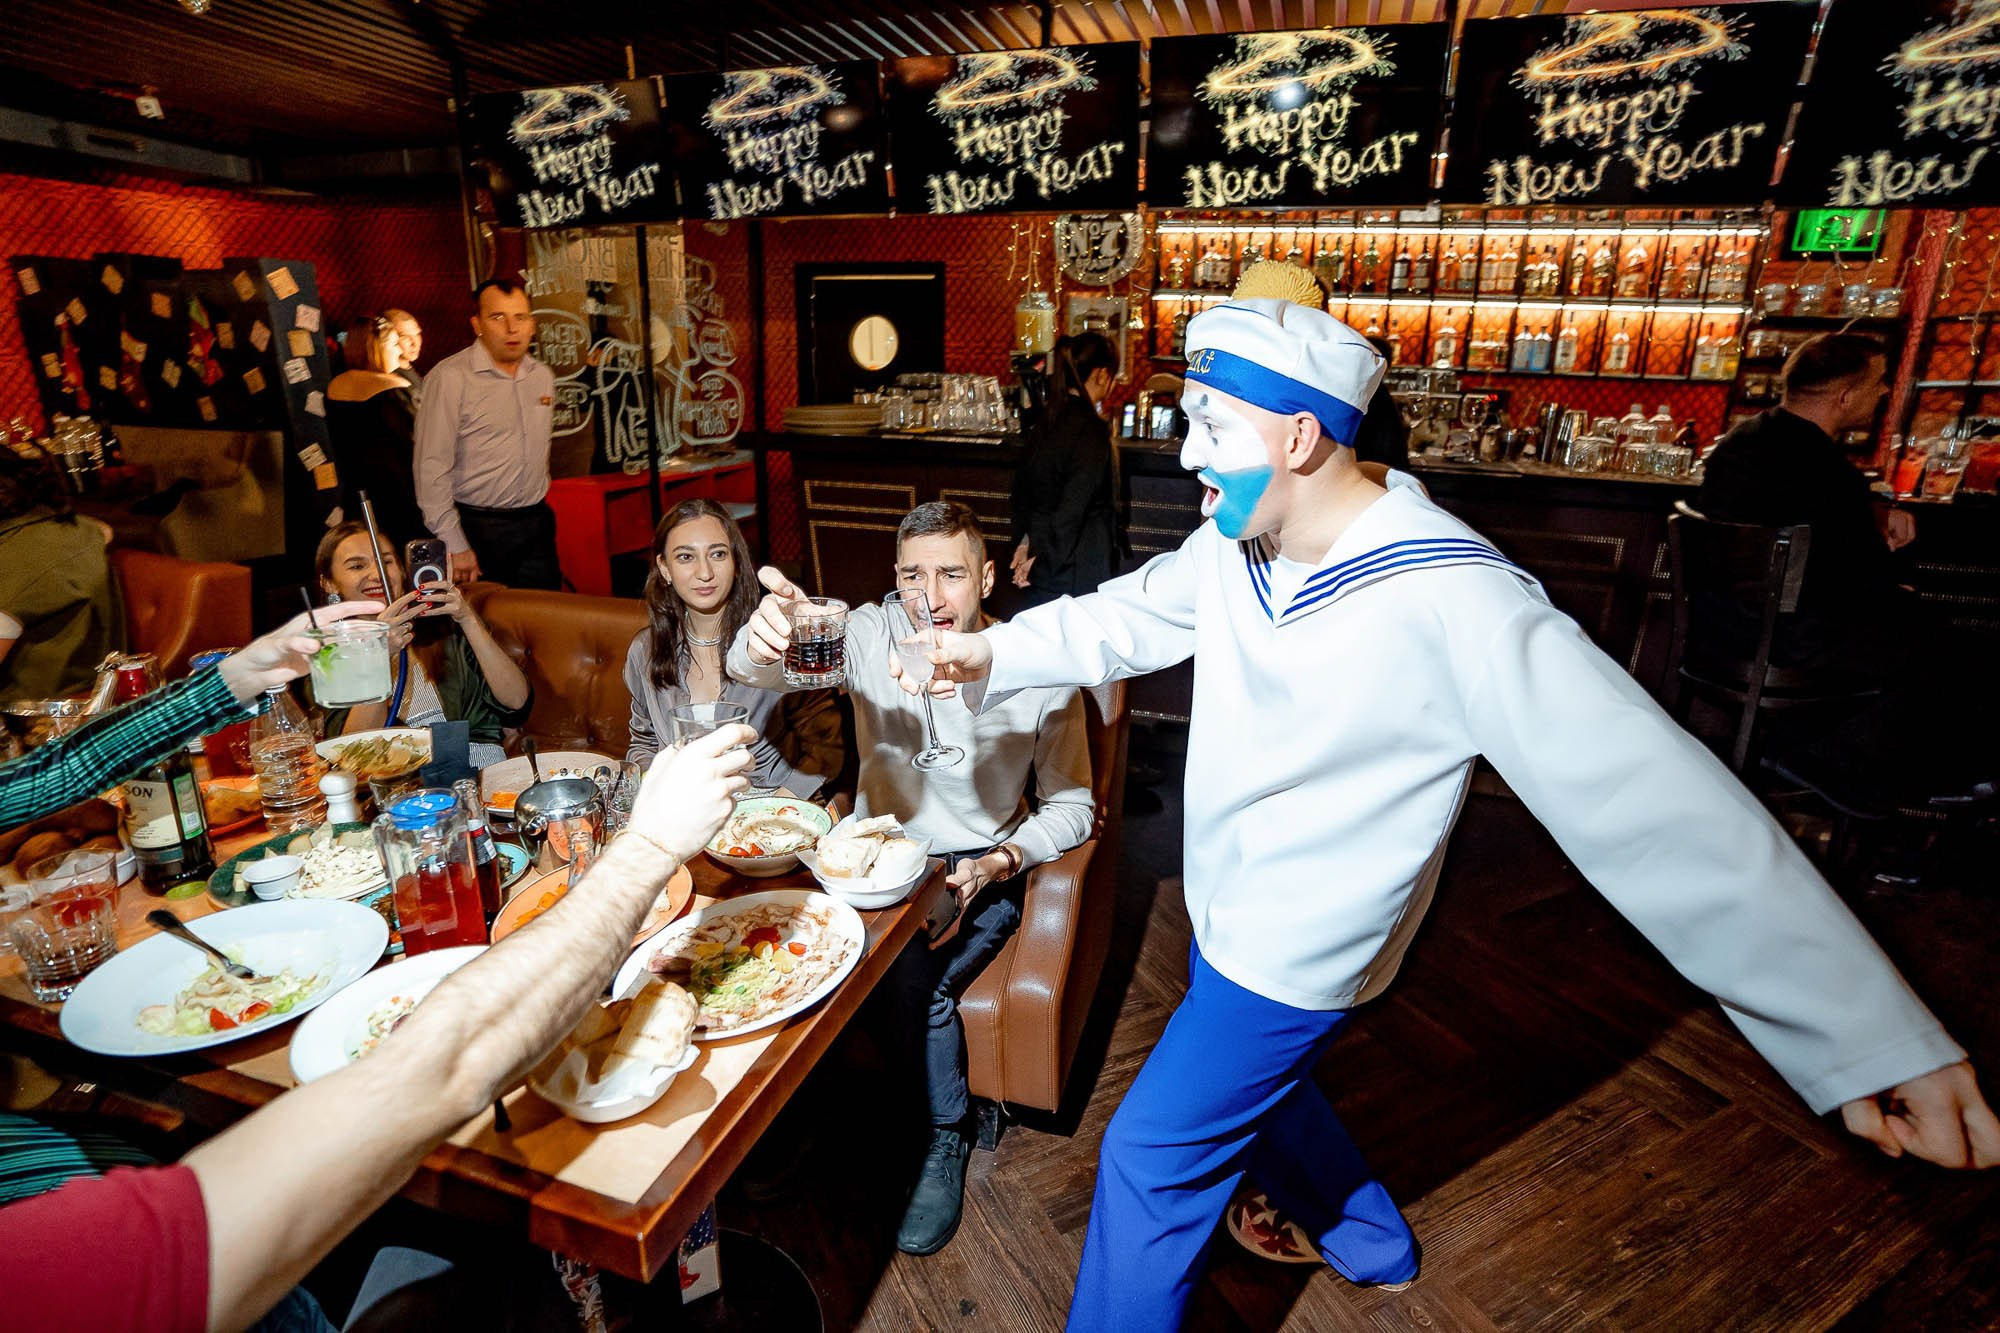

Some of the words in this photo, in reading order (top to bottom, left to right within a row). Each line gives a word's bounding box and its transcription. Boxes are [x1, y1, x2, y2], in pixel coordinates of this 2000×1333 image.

[727, 120, 822, 172] Happy
[954, 108, 1067, 164] Happy
[1221, 94, 1355, 155] Happy
[1536, 81, 1697, 147] Happy
[529, 135, 612, 184] Happy
[707, 178, 784, 219] New
[790, 151, 874, 204] Year
[926, 171, 1017, 214] New
[1024, 141, 1125, 199] Year
[1185, 161, 1291, 207] New
[1300, 131, 1420, 192] Year
[1485, 156, 1610, 205] New
[1624, 122, 1766, 190] Year
[1828, 150, 1989, 206] New
[517, 188, 584, 227] New
[588, 163, 660, 213] Year
